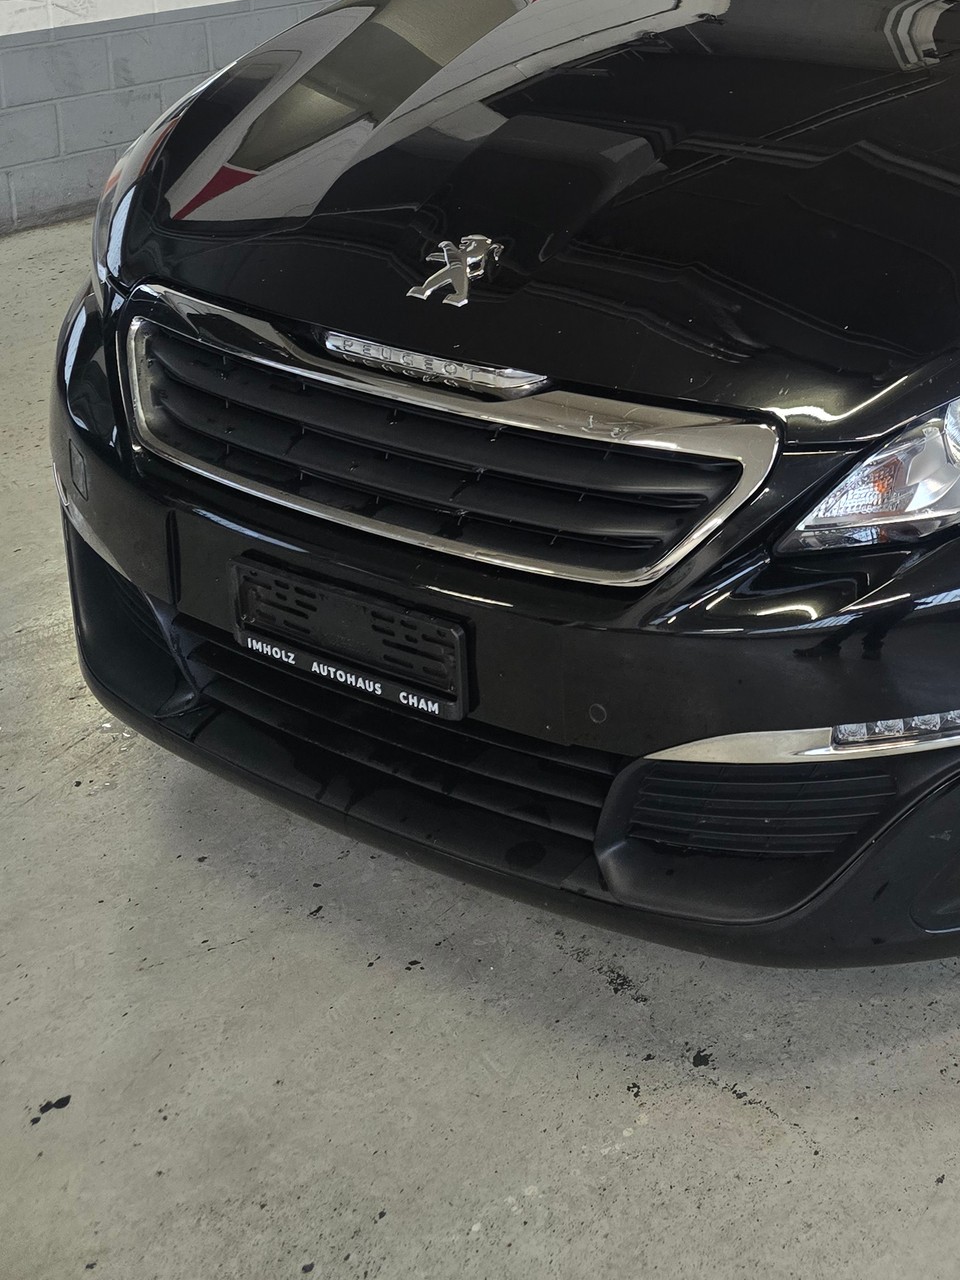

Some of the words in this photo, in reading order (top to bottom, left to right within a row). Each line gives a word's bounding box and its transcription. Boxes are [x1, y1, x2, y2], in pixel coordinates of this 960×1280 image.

[343, 339, 479, 382] PEUGEOT
[247, 637, 296, 665] IMHOLZ
[311, 662, 382, 695] AUTOHAUS
[400, 691, 439, 715] CHAM
